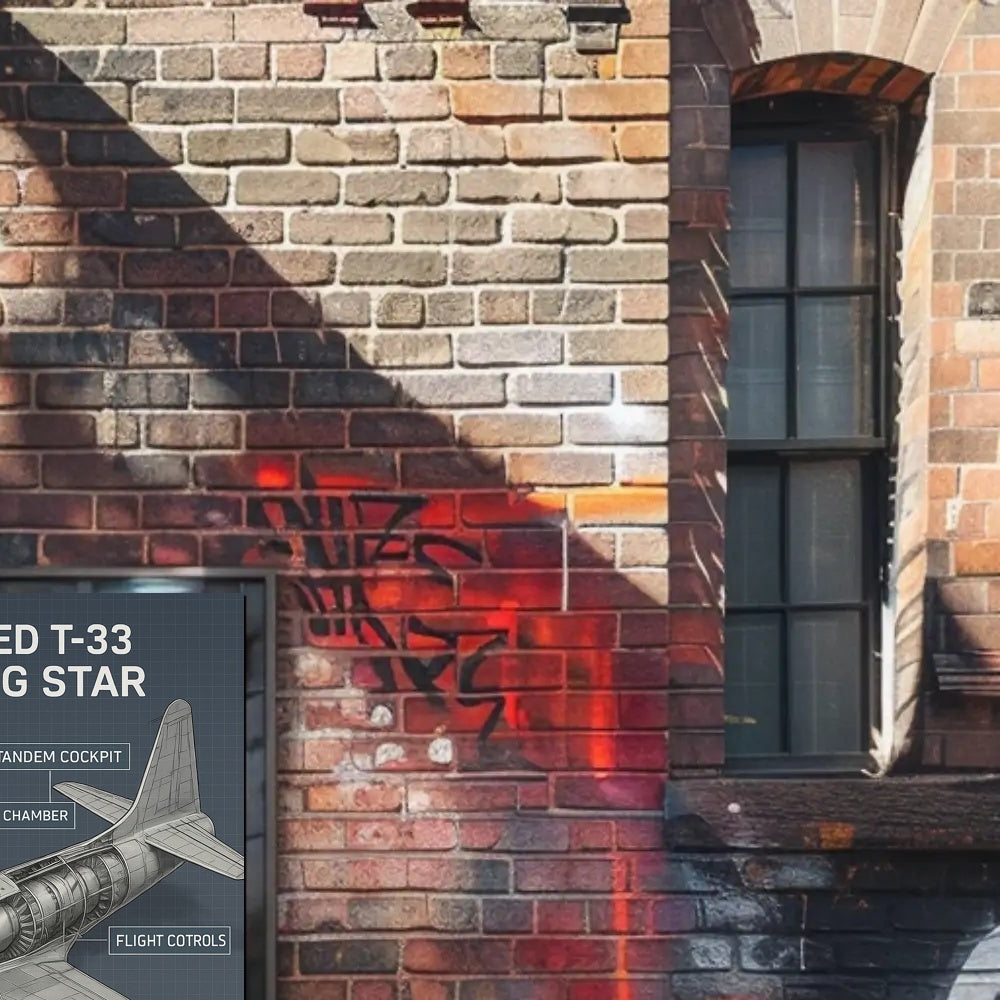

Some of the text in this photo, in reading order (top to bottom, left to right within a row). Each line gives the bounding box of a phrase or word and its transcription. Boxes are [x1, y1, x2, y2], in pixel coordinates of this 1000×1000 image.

[50, 623, 132, 655] T-33
[42, 665, 146, 698] STAR
[60, 750, 123, 763] COCKPIT
[3, 809, 69, 822] CHAMBER
[116, 933, 227, 947] FLIGHT COTROLS
